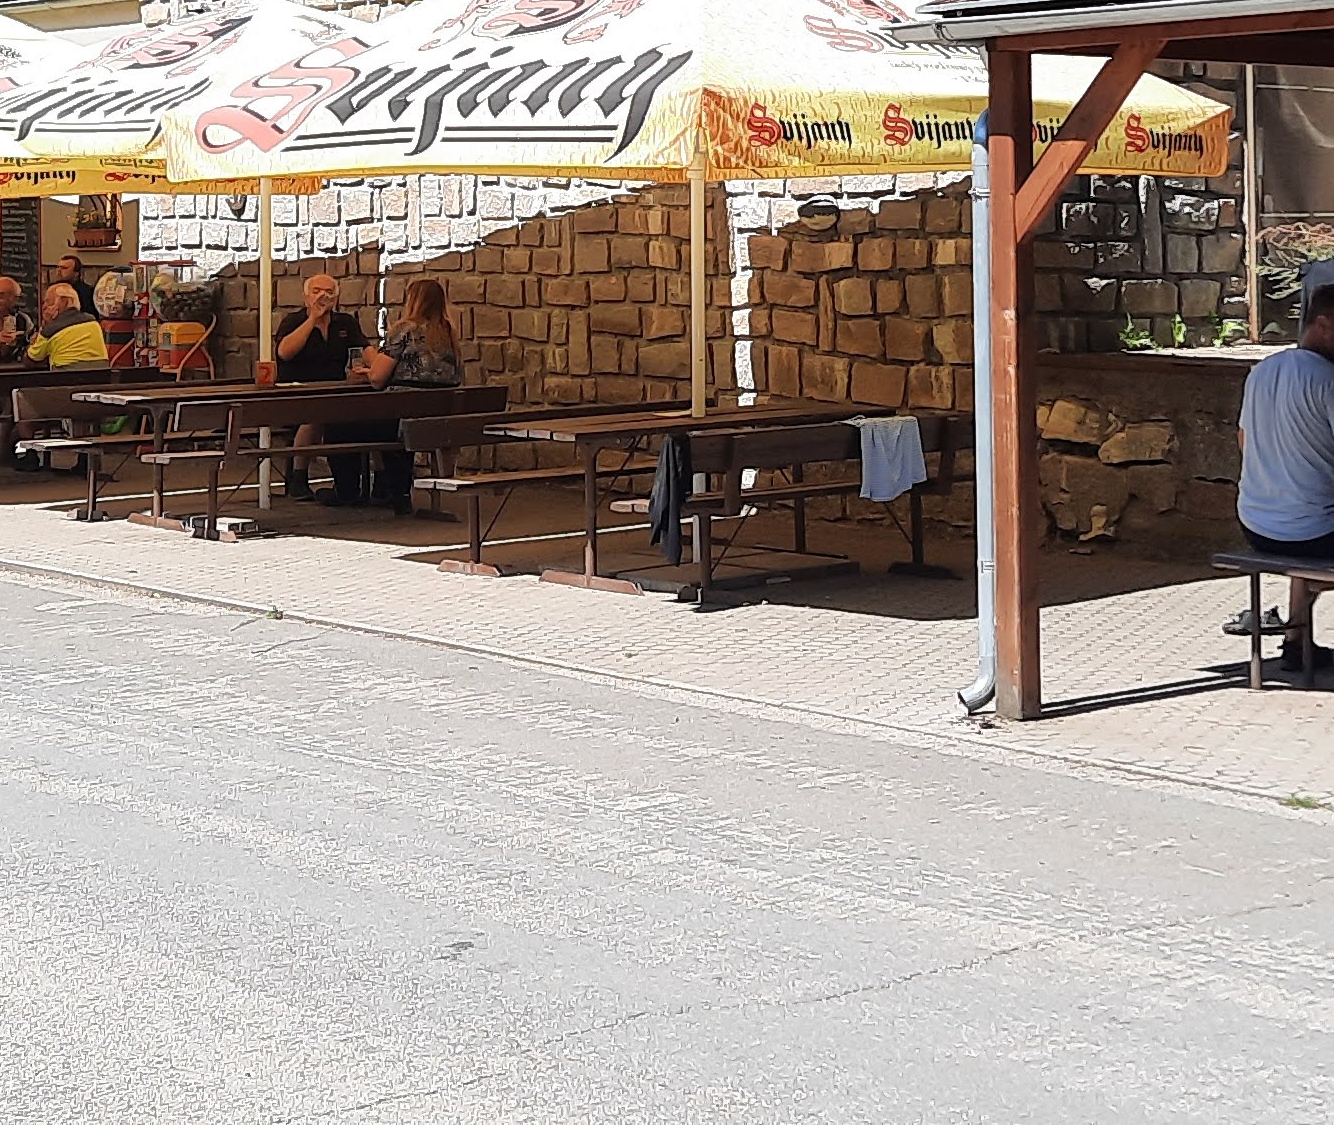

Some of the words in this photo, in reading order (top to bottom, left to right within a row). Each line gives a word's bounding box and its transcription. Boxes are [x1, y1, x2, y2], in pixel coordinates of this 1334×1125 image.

[195, 36, 693, 163] Svijany
[747, 102, 853, 150] Svijany
[1123, 113, 1204, 159] Svijany
